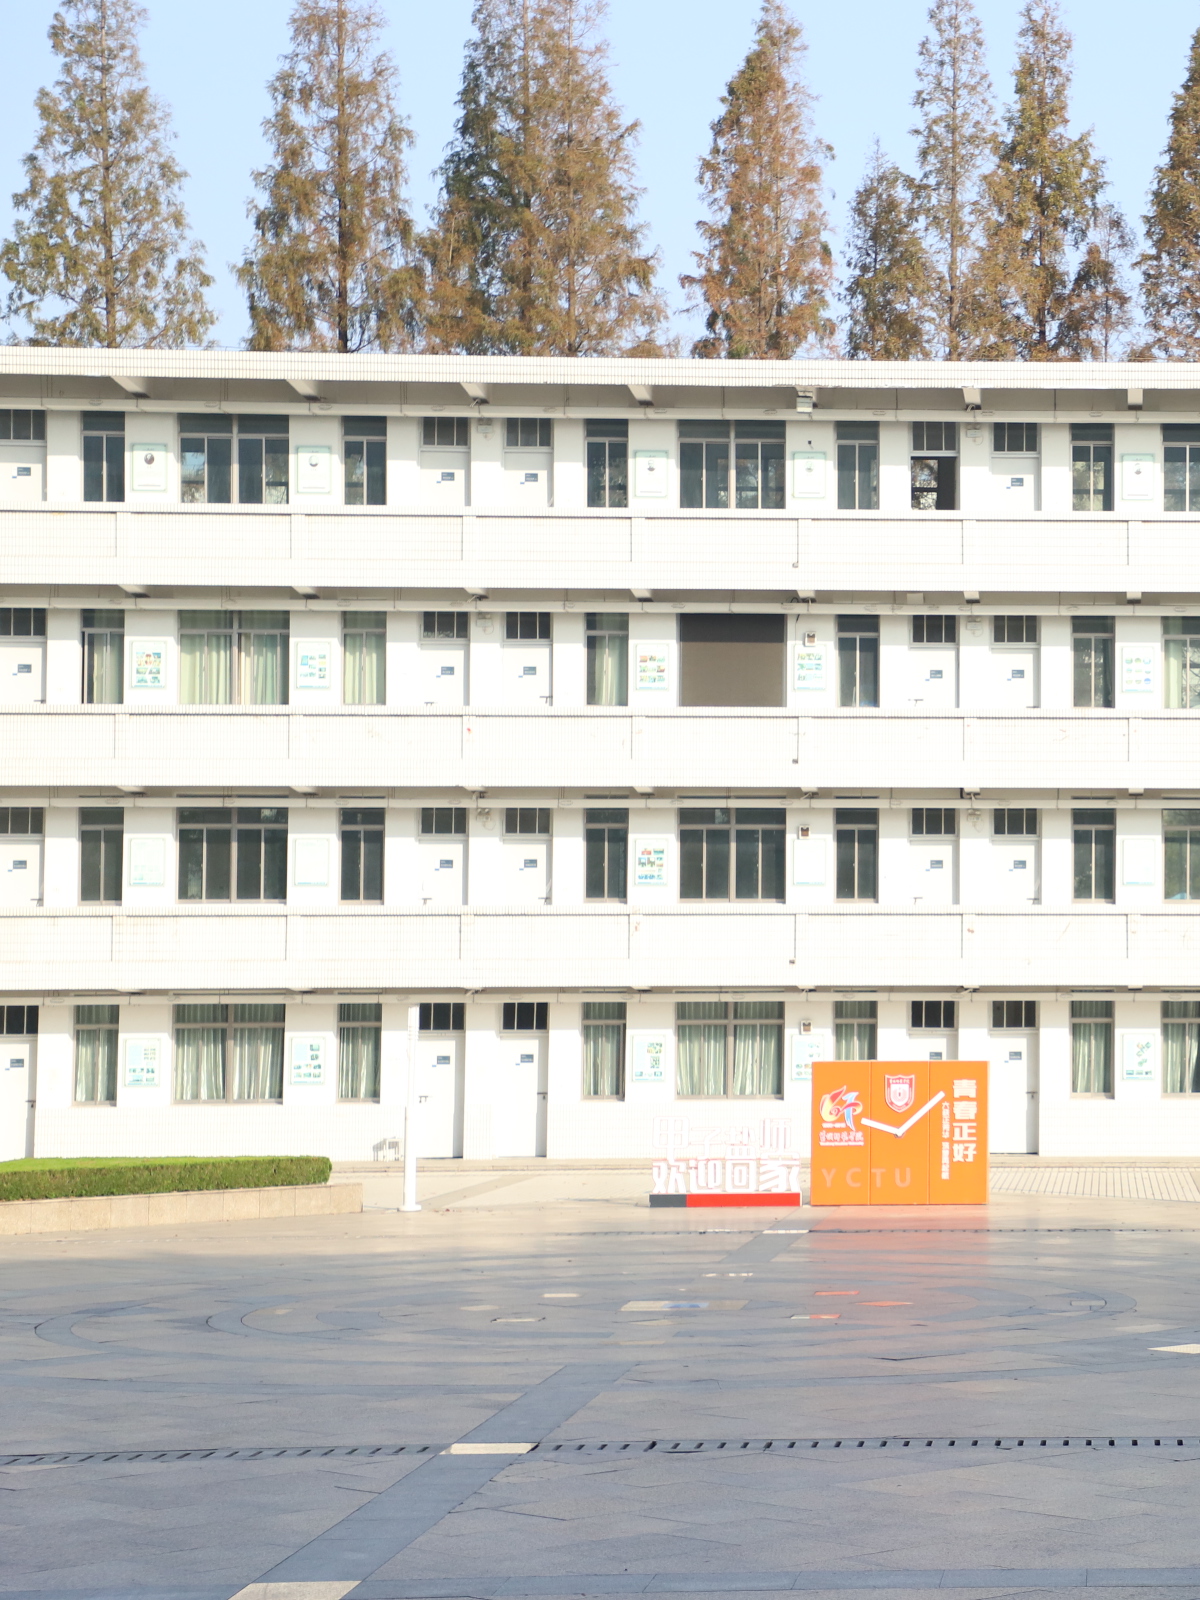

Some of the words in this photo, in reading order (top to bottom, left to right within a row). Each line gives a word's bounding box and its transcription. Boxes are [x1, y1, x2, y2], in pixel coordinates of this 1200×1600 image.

[952, 1079, 978, 1163] 青春正好
[652, 1152, 801, 1194] 欢迎回家
[821, 1167, 912, 1188] YCTU
